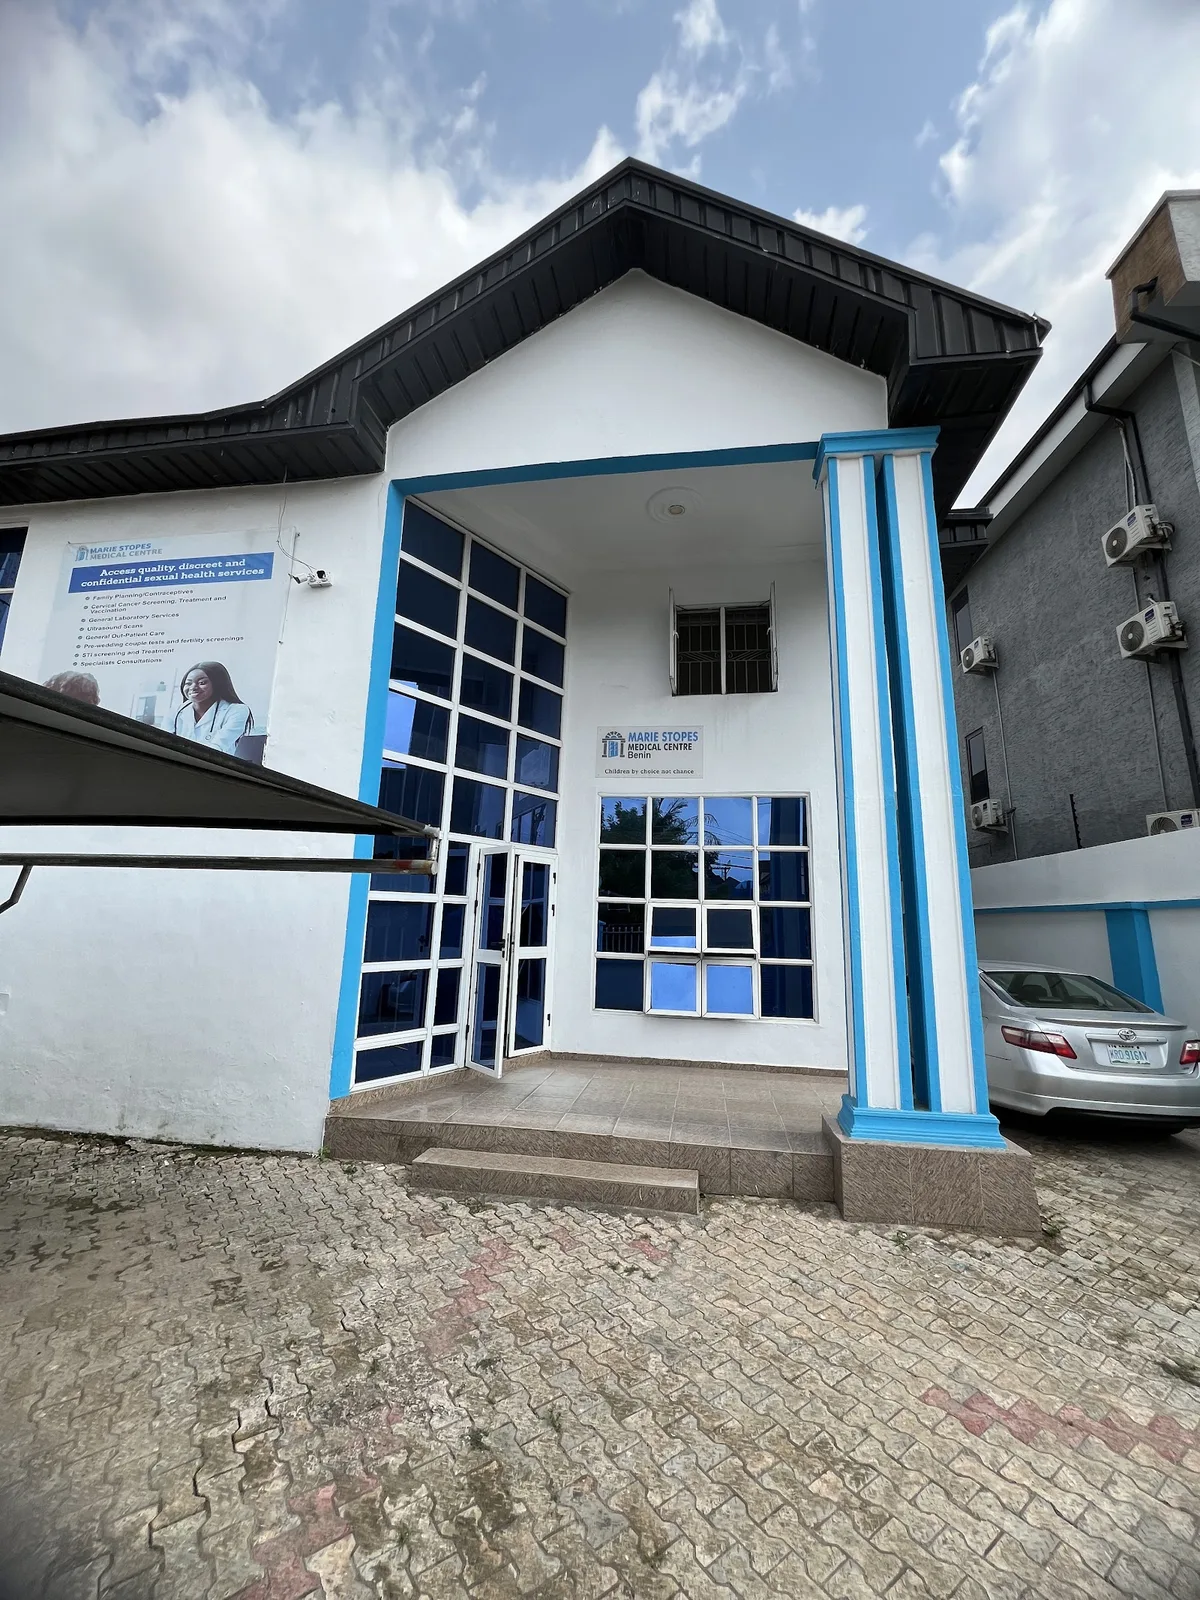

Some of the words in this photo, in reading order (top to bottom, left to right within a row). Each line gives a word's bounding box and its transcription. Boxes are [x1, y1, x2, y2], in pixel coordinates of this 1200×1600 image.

[119, 543, 151, 552] STOPES
[90, 551, 127, 560] MEDICAL
[128, 548, 163, 557] CENTRE
[100, 567, 136, 577] Access
[178, 561, 223, 570] discreet
[225, 559, 245, 567] and
[80, 575, 142, 587] confidential
[143, 573, 178, 582] sexual
[181, 570, 216, 579] health
[217, 568, 264, 577] services
[115, 589, 193, 598] Planning/Contraceptives
[628, 732, 658, 742] MARIE
[662, 731, 698, 742] STOPES
